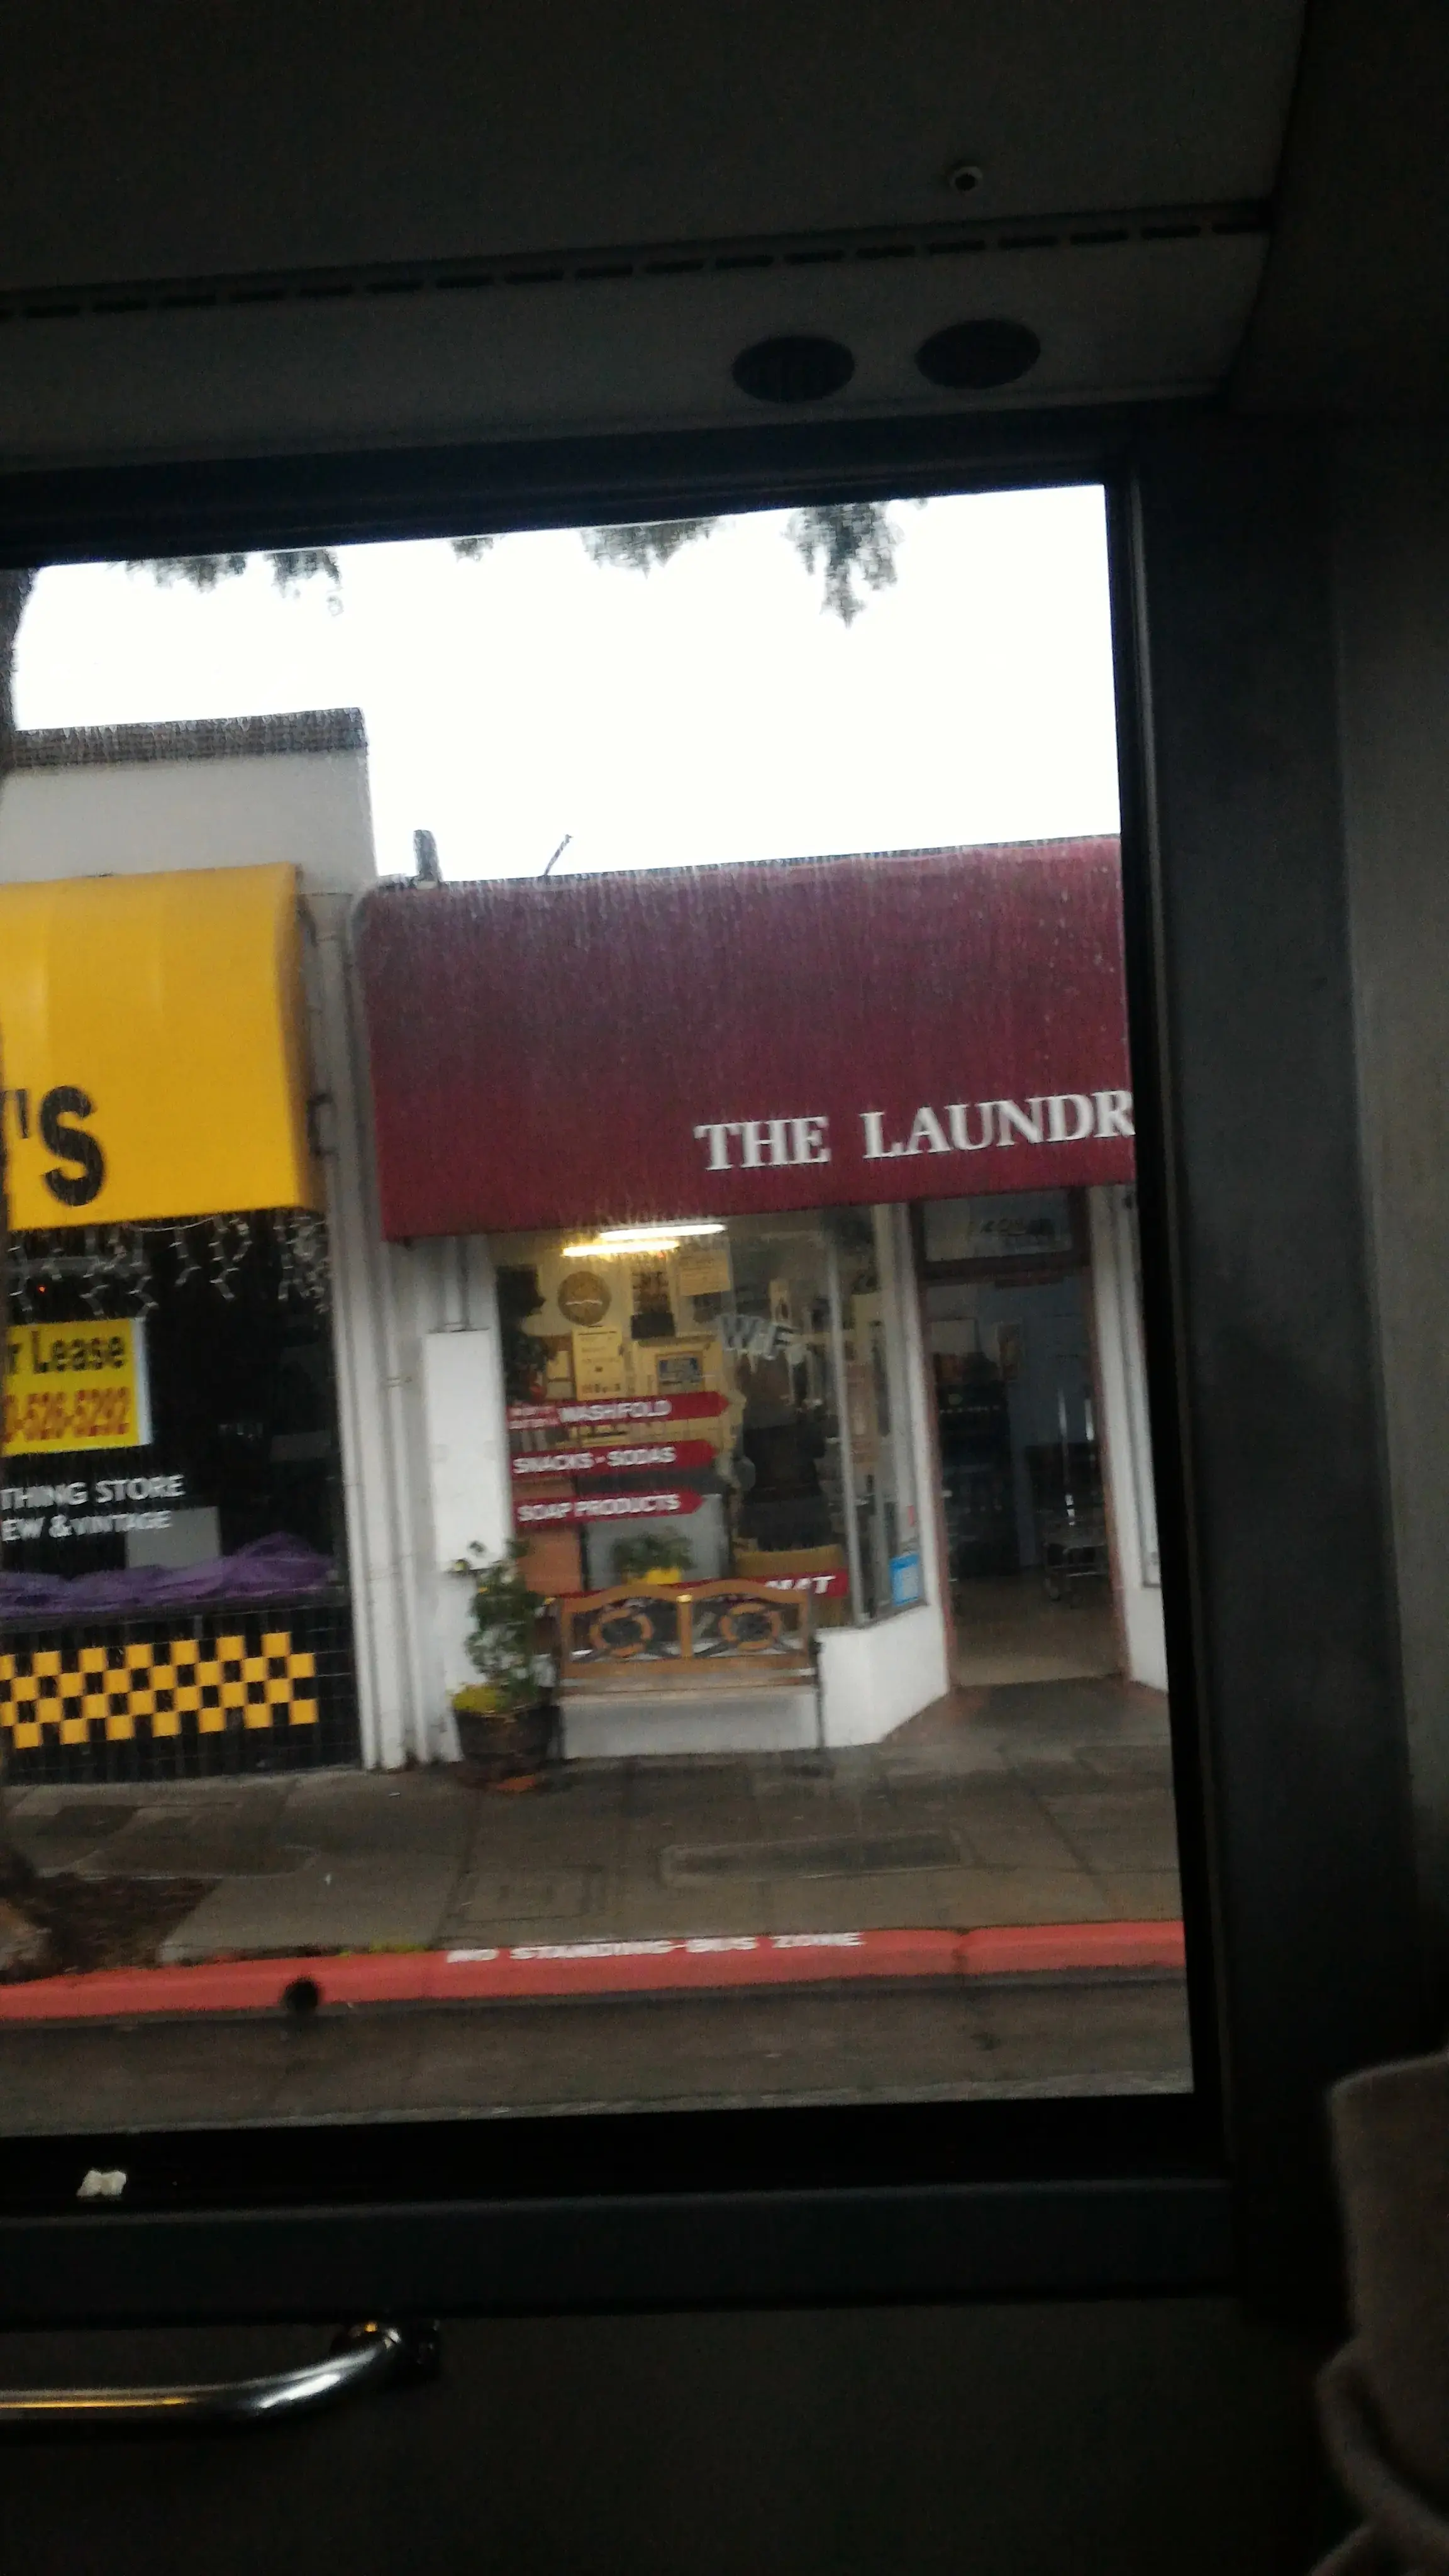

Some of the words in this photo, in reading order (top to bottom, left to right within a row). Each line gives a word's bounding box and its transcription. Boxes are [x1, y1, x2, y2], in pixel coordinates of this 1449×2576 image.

[694, 1116, 831, 1171] THE
[860, 1090, 1135, 1159] LAUNDR
[31, 1331, 125, 1374] Lease
[513, 1452, 595, 1474] SNACKS
[606, 1446, 677, 1467] SODAS
[95, 1474, 186, 1503] STORE
[517, 1502, 573, 1521] SOAP
[574, 1494, 681, 1517] PRODUCTS
